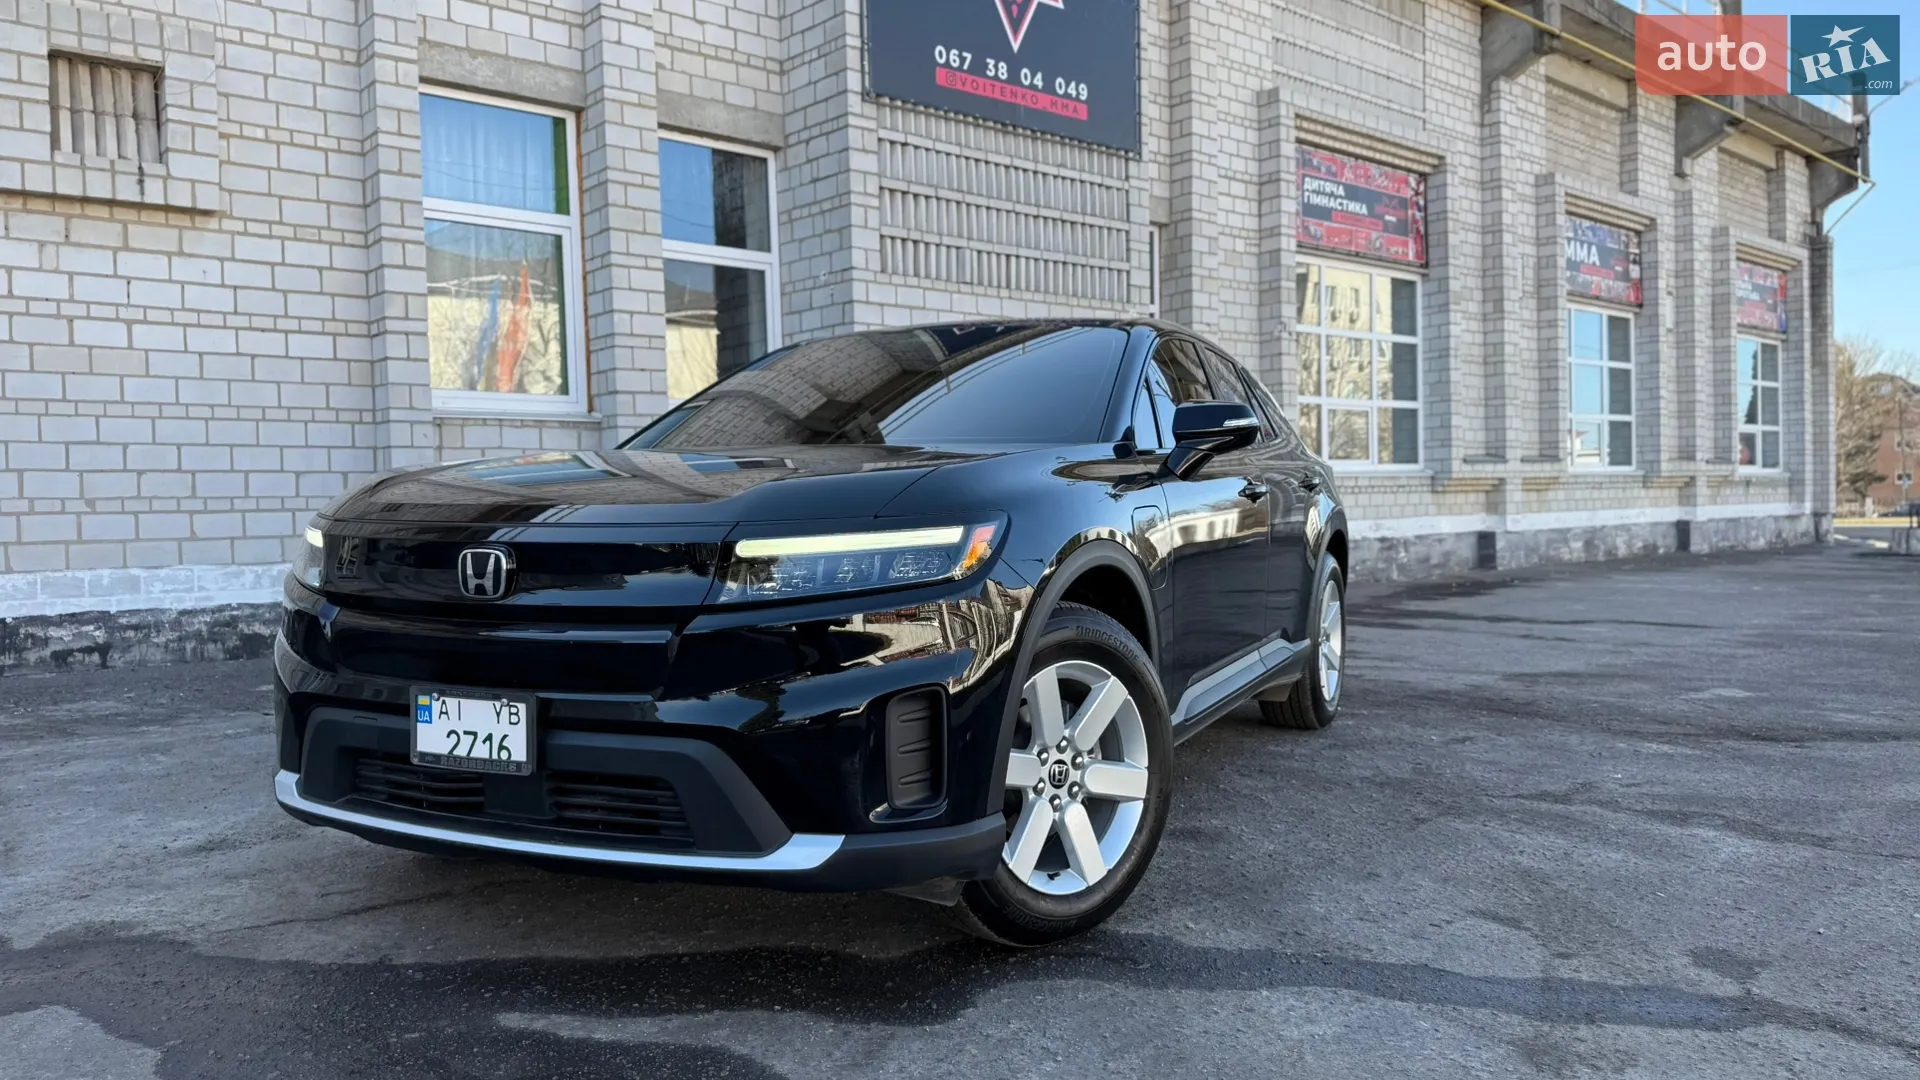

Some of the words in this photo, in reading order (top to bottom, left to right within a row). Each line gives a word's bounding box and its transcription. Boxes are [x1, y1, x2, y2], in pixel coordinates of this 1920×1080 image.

[934, 45, 972, 70] 067
[985, 58, 1008, 80] 38
[1020, 68, 1043, 89] 04
[1055, 77, 1088, 100] 049
[1303, 177, 1345, 197] ДИТЯЧА
[1303, 191, 1369, 215] ГІМНАСТИКА
[1075, 625, 1140, 661] BRIDGESTONE
[417, 709, 431, 722] UA
[438, 699, 462, 721] AI
[493, 701, 521, 726] YB
[446, 729, 512, 761] 2716
